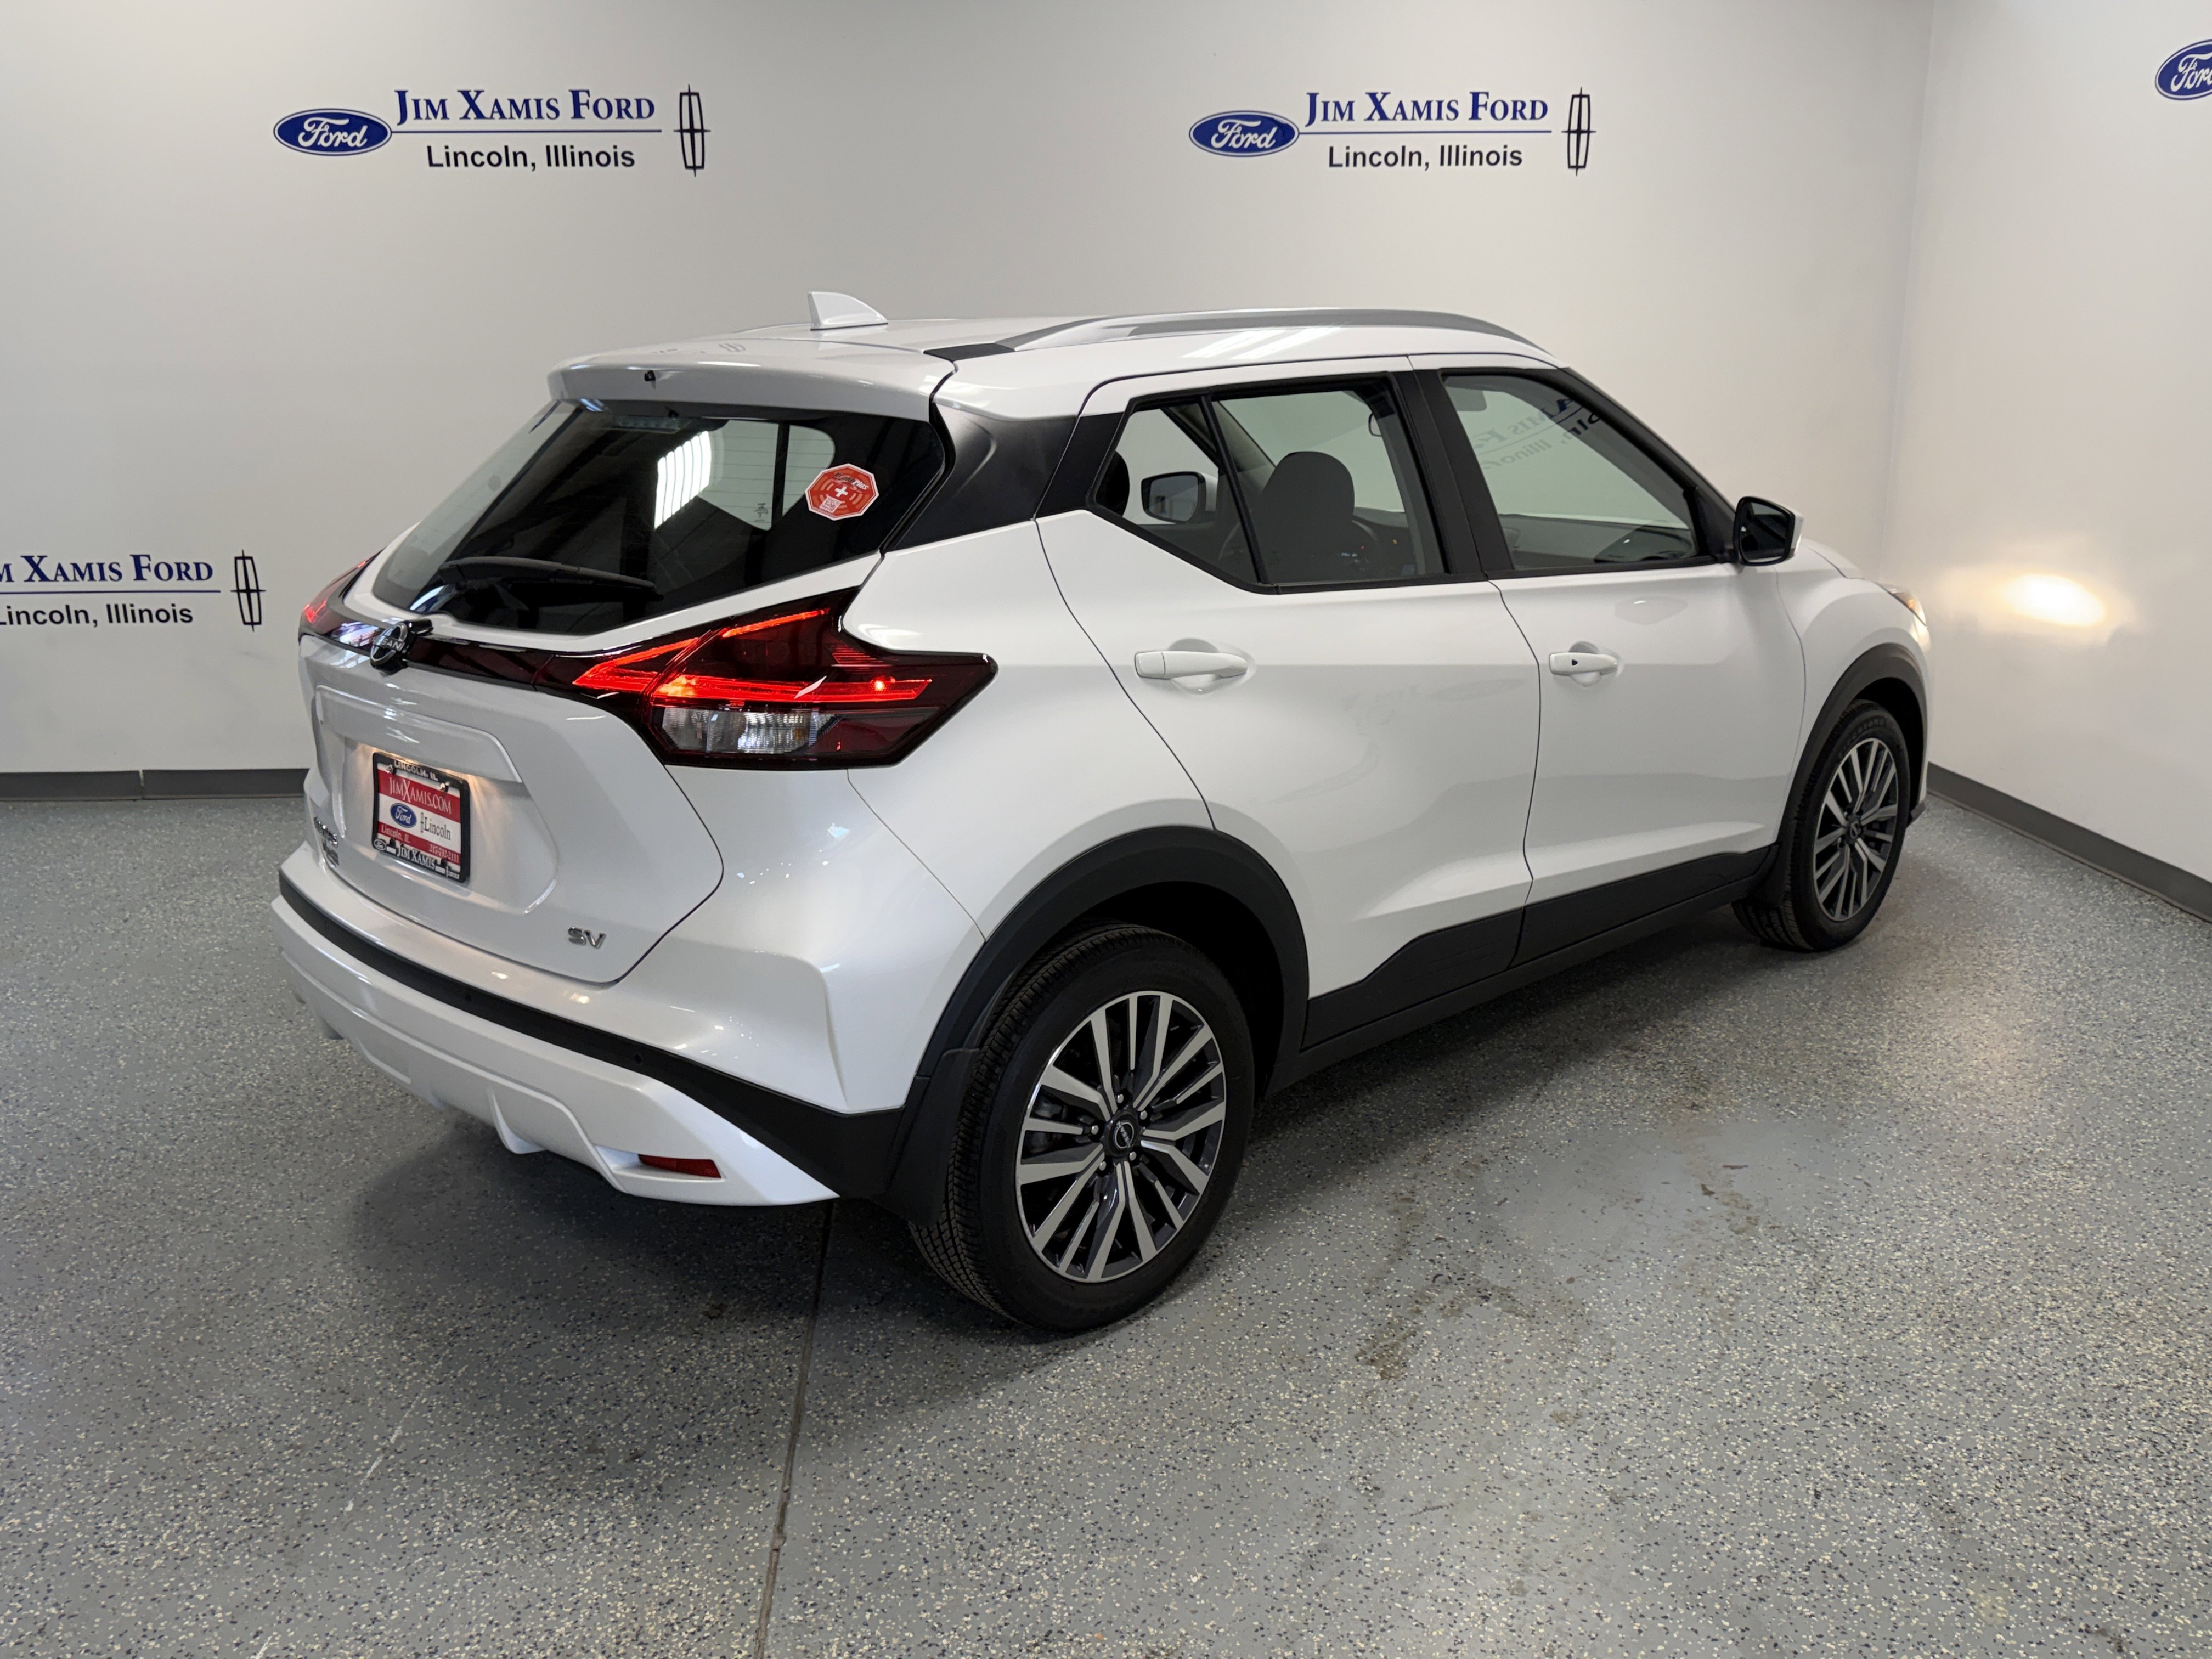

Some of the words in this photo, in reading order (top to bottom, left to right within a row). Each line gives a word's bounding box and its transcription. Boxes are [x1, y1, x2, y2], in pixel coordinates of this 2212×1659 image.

[2170, 52, 2212, 92] For
[394, 89, 450, 126] JIM
[457, 89, 560, 120] XAMIS
[568, 89, 655, 120] FORD
[1305, 92, 1355, 127] JIM
[1364, 91, 1459, 121] XAMIS
[1469, 91, 1548, 121] FORD
[297, 116, 369, 148] Ford
[1210, 119, 1278, 149] Ford
[427, 144, 536, 172] Lincoln,
[545, 145, 635, 168] Illinois
[1328, 145, 1429, 171] Lincoln,
[1440, 144, 1522, 166] Illinois
[20, 555, 123, 583] XAMIS
[129, 554, 213, 582] FORD
[105, 603, 194, 624] Illinois
[430, 772, 438, 781] IL
[395, 806, 411, 825] Ford
[425, 816, 452, 840] Lincoln
[397, 846, 410, 857] JIM
[411, 849, 436, 869] XAMIS
[568, 926, 607, 949] SV
